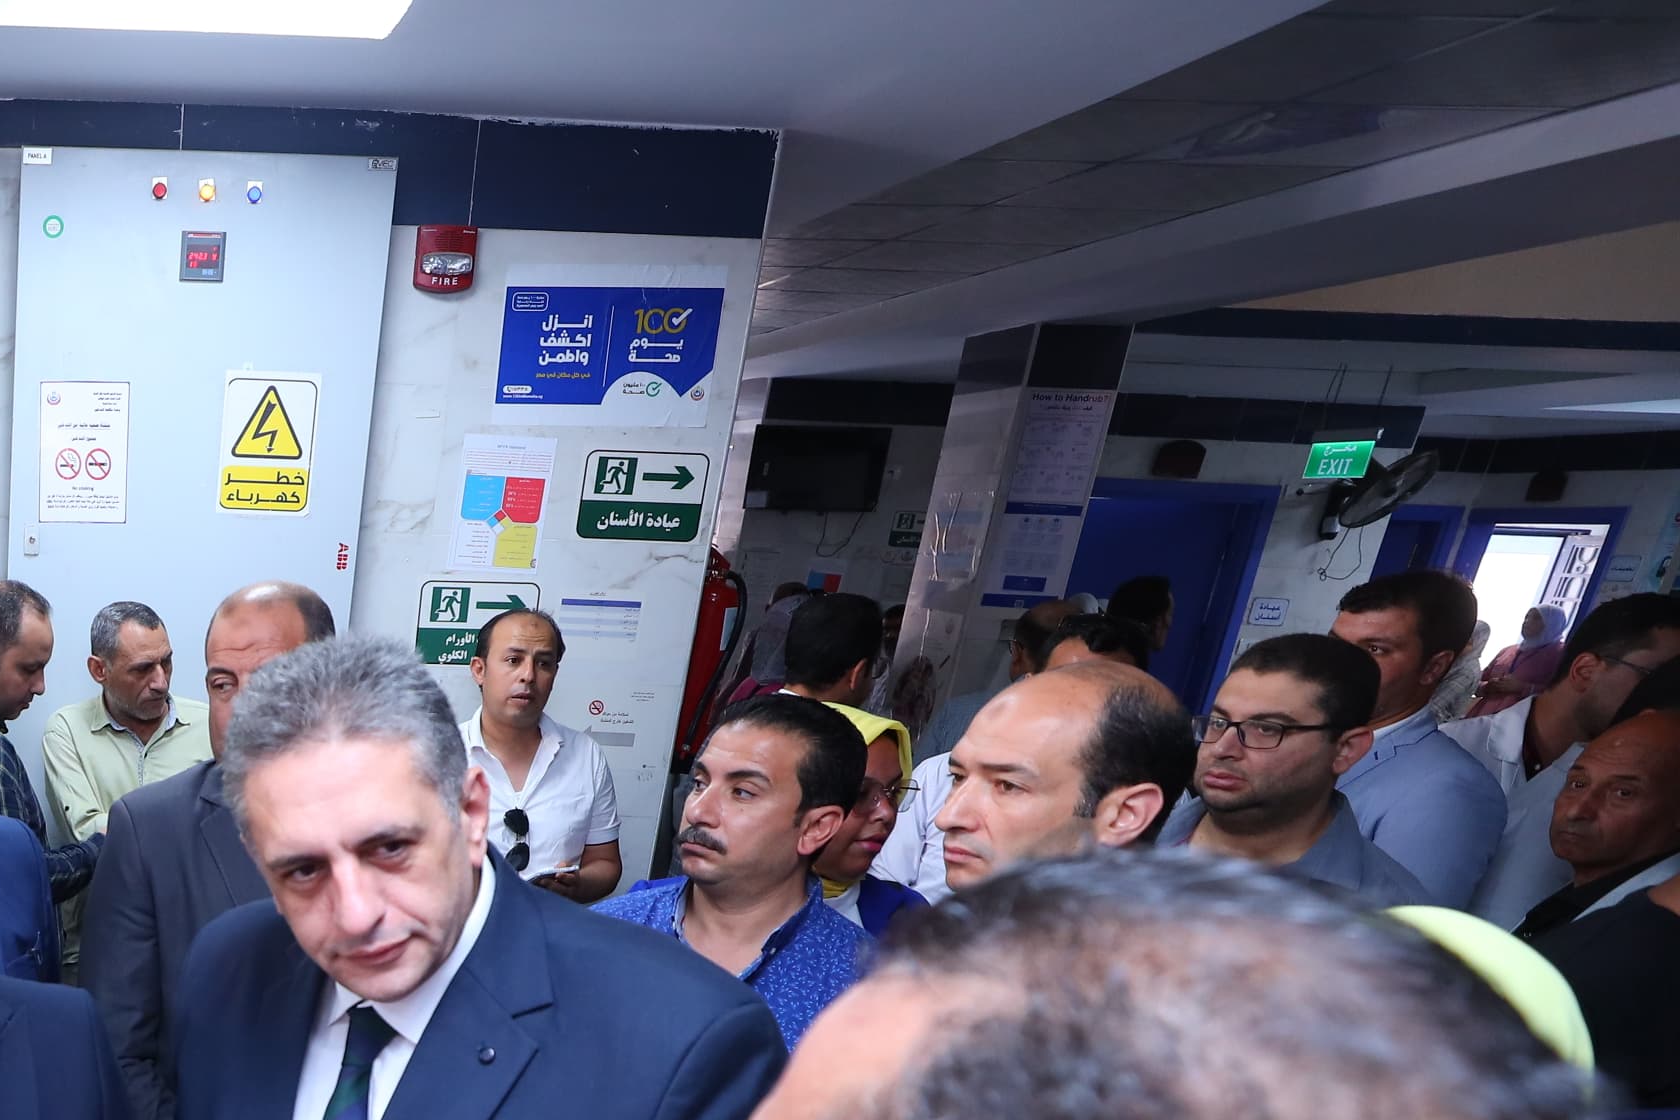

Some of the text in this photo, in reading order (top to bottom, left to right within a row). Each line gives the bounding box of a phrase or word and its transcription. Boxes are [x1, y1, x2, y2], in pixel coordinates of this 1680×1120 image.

[431, 276, 459, 286] FIRE
[542, 313, 593, 332] انزل
[634, 307, 688, 335] 100
[539, 329, 593, 348] اكشف
[629, 337, 685, 350] يوم
[538, 348, 590, 367] واطمن
[628, 349, 681, 363] صحة
[1032, 392, 1051, 401] How
[1054, 392, 1064, 401] to
[1317, 458, 1353, 476] EXIT
[224, 470, 305, 486] خطر
[226, 488, 301, 505] كهرباء
[596, 508, 681, 532] عيادة الأسنان
[336, 542, 350, 571] ABB
[445, 631, 476, 647] الأورام
[438, 649, 468, 665] الكلوي
